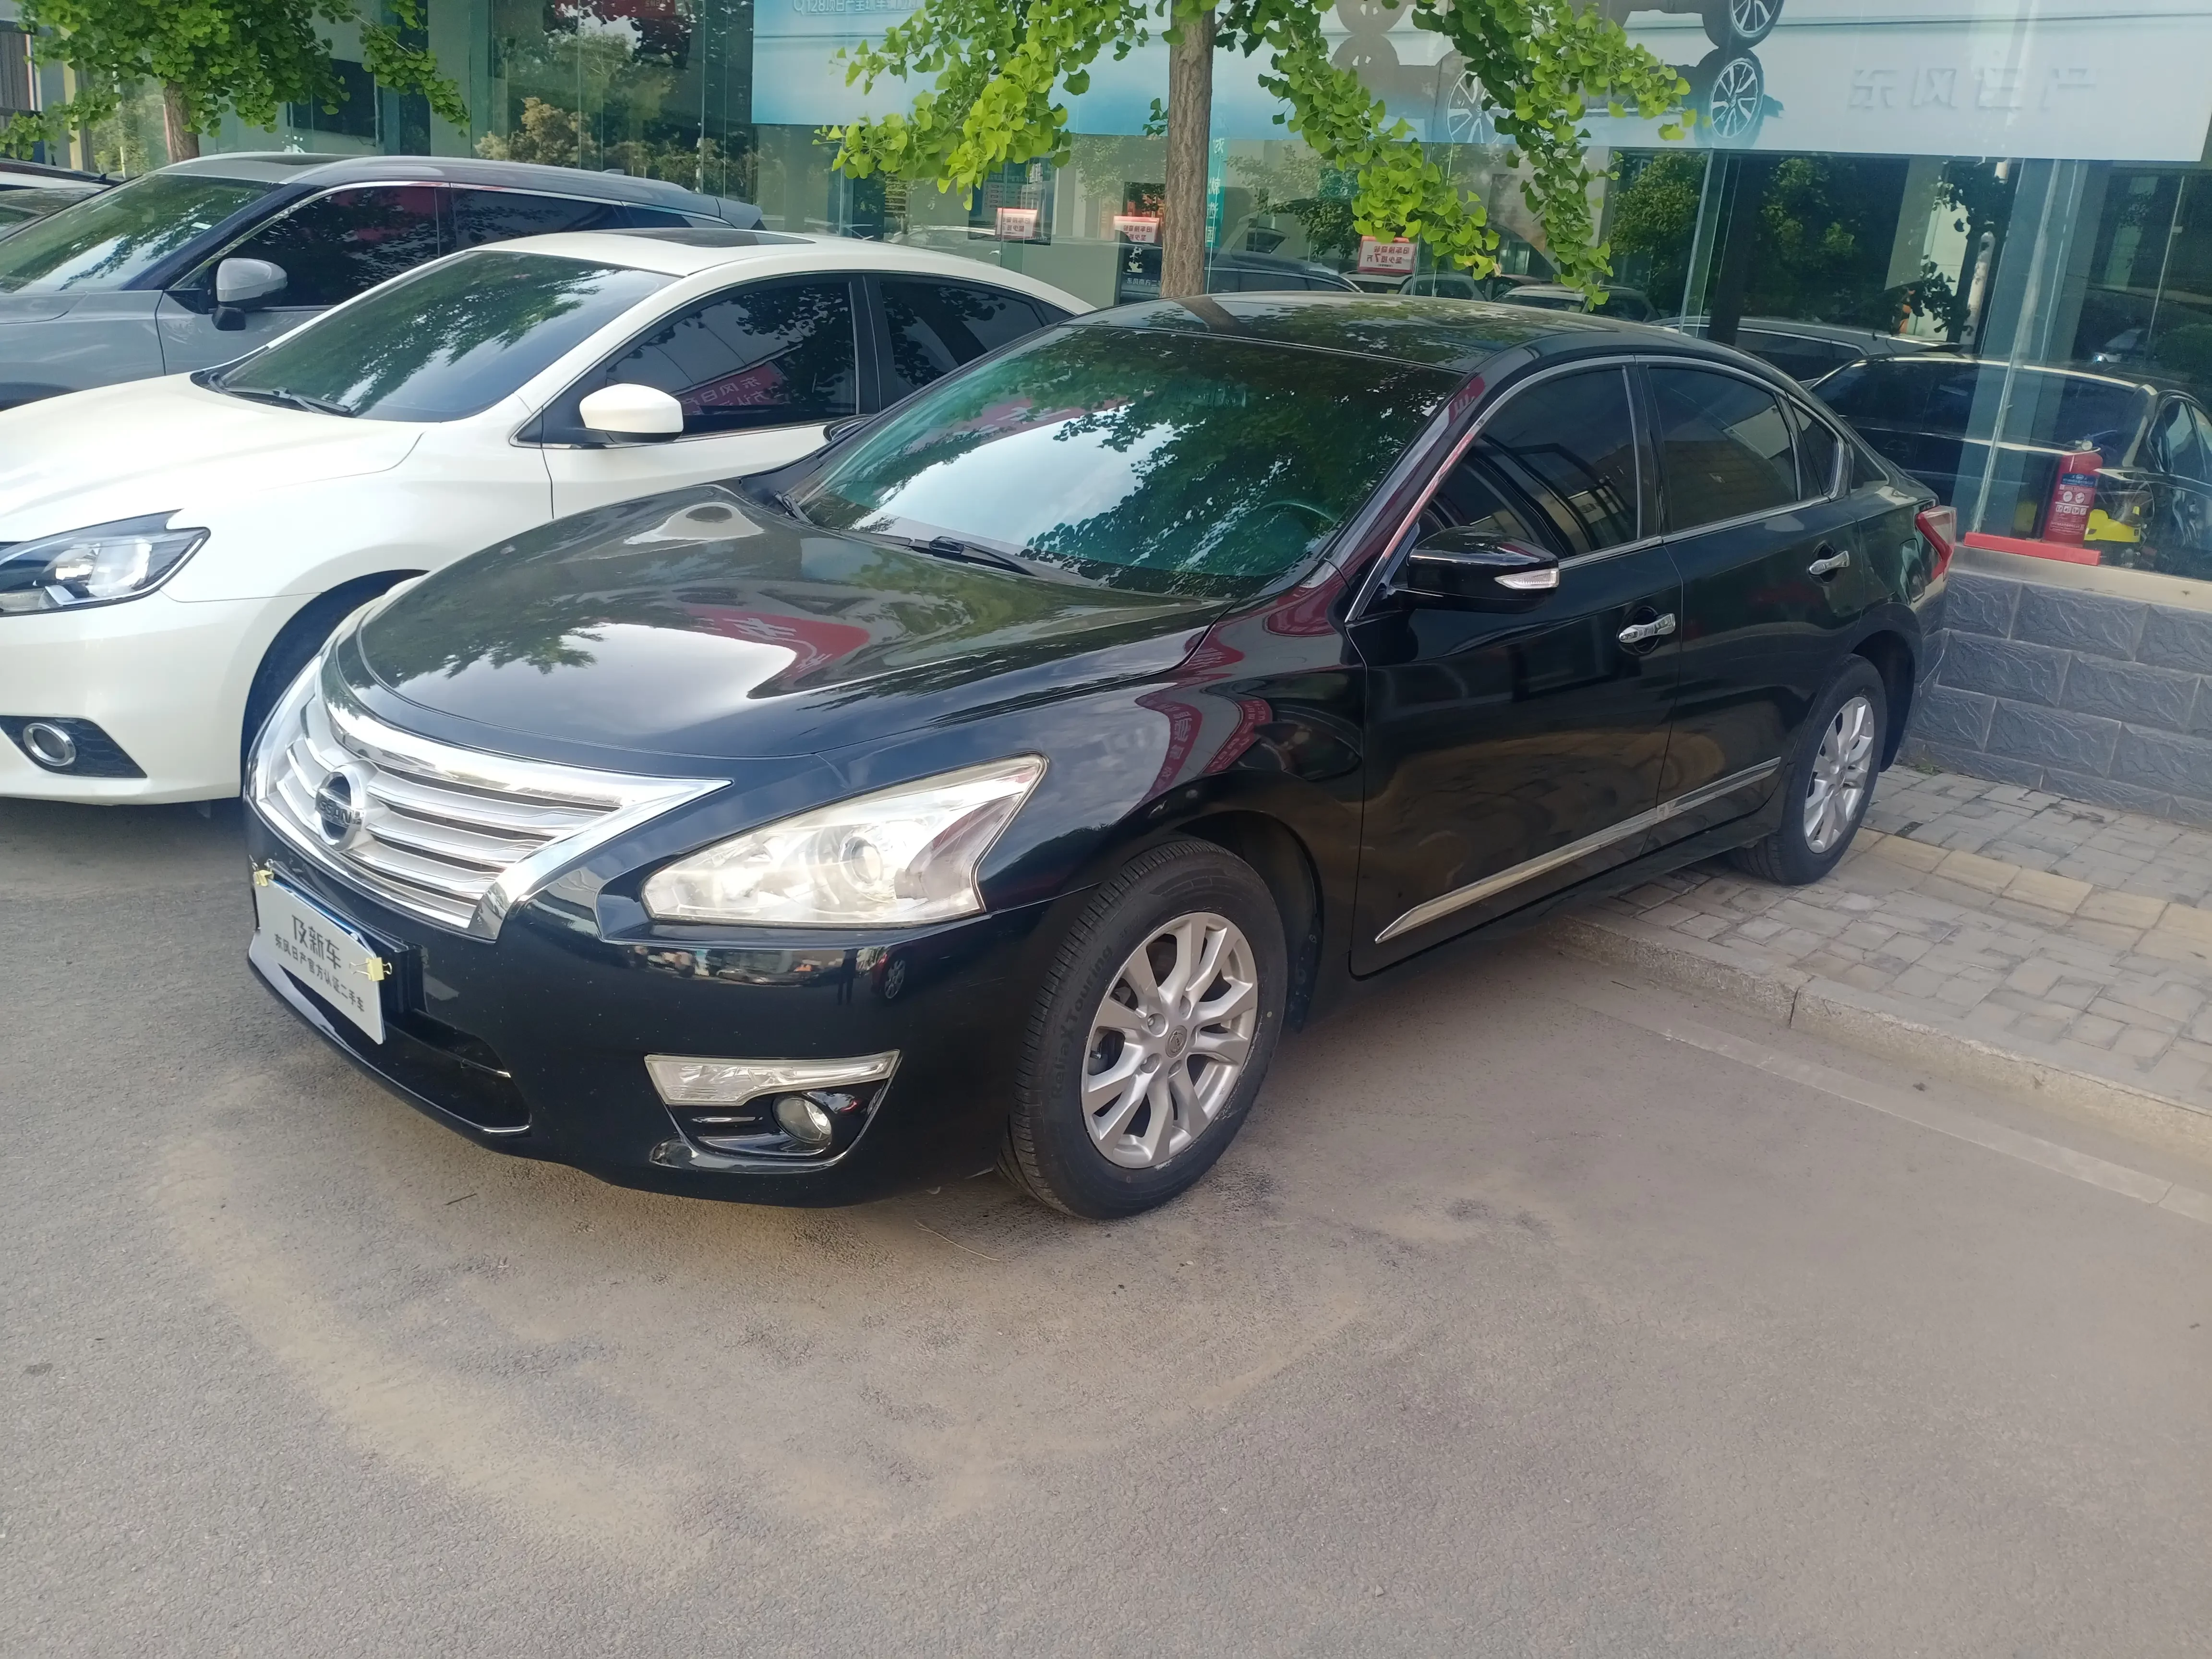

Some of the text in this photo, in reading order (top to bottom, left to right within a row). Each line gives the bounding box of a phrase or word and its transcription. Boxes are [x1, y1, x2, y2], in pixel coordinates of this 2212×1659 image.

[274, 933, 365, 1012] 东风日产官方认证二手车
